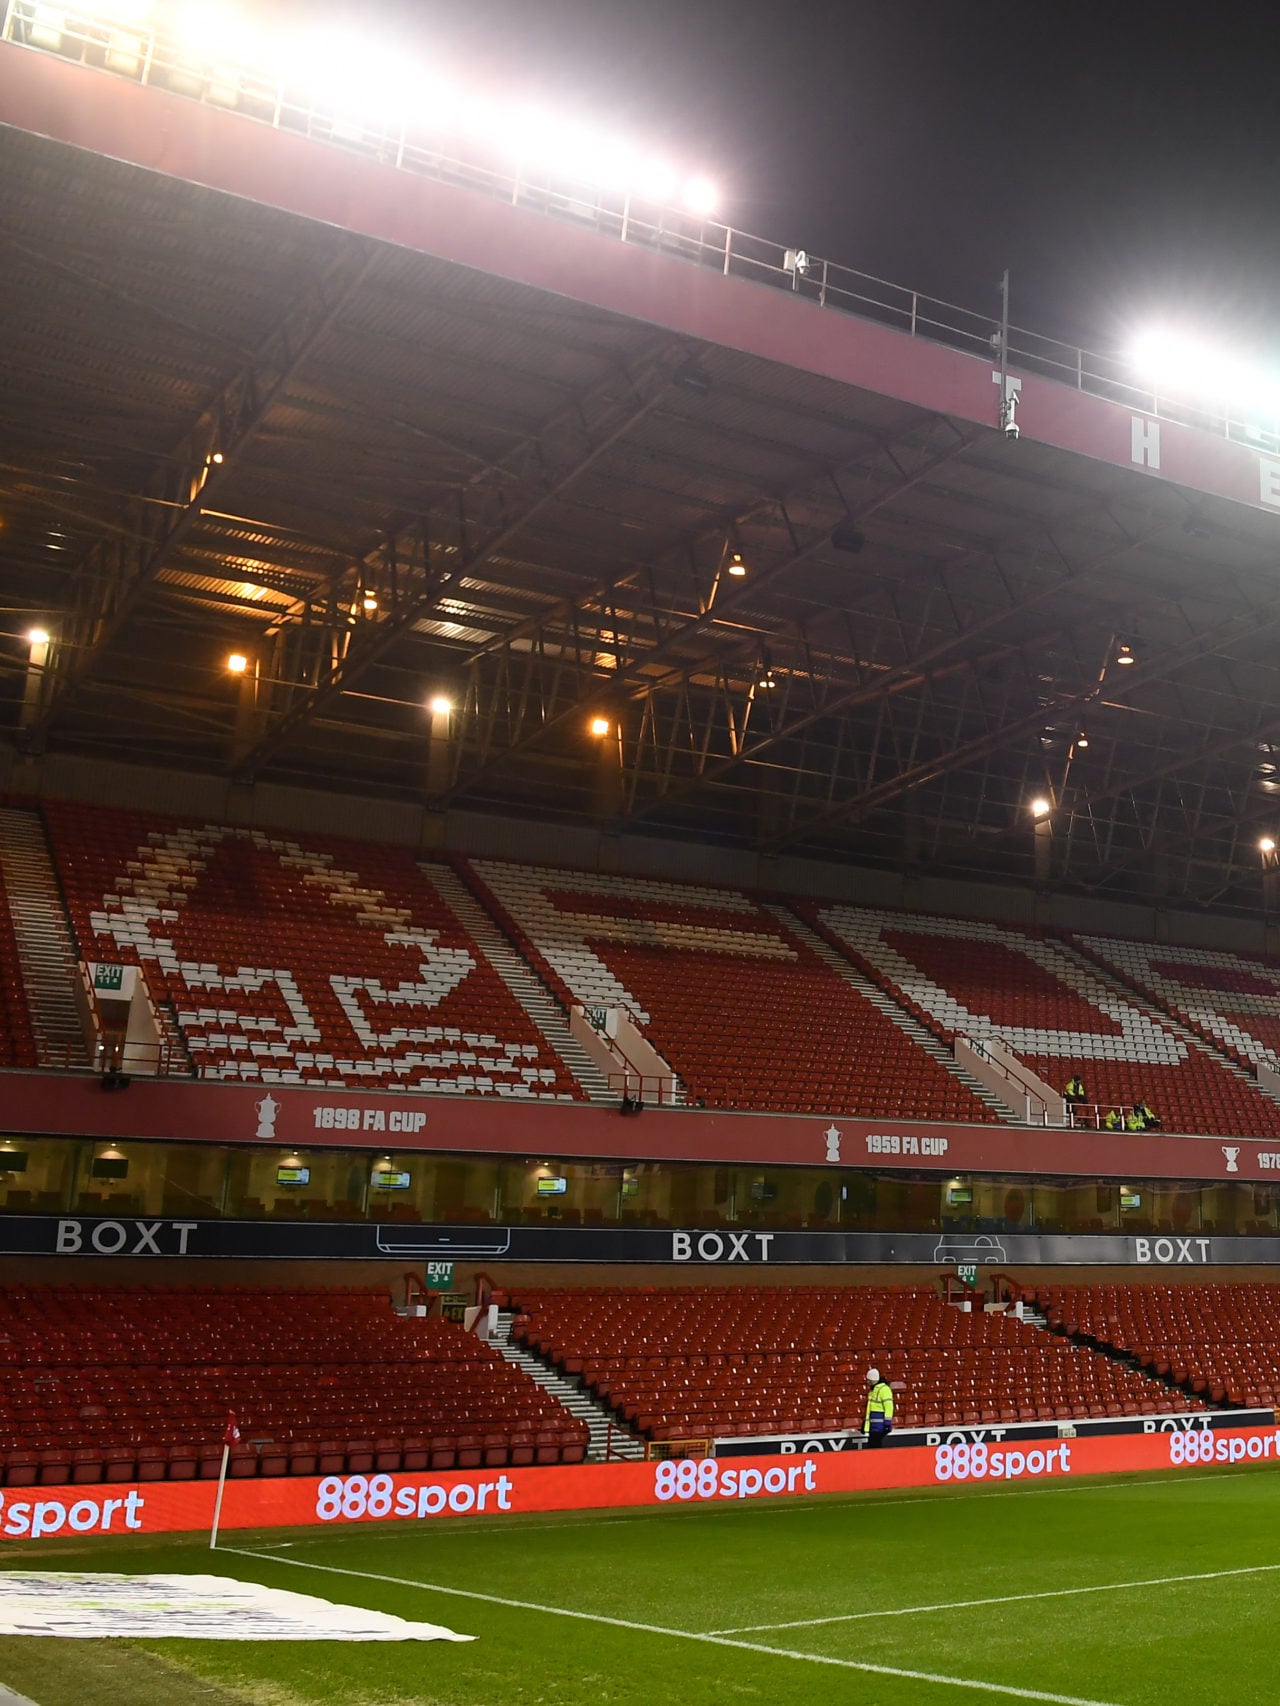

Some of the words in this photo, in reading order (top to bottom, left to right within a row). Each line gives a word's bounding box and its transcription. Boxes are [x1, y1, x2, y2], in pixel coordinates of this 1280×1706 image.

[96, 964, 123, 978] EXIT
[313, 1107, 360, 1130] 1898
[363, 1109, 386, 1131] FA
[389, 1111, 427, 1133] CUP
[865, 1135, 901, 1154] 1959
[902, 1136, 919, 1155] FA
[921, 1137, 948, 1156] CUP
[56, 1220, 198, 1254] BOXT
[672, 1232, 775, 1261] BOXT
[1135, 1238, 1211, 1264] BOXT
[427, 1262, 453, 1274] EXIT
[957, 1265, 977, 1276] EXIT
[934, 1441, 1071, 1480] 888sport
[655, 1459, 816, 1499] 888sport
[316, 1474, 512, 1520] 888sport
[0, 1490, 144, 1538] sport
